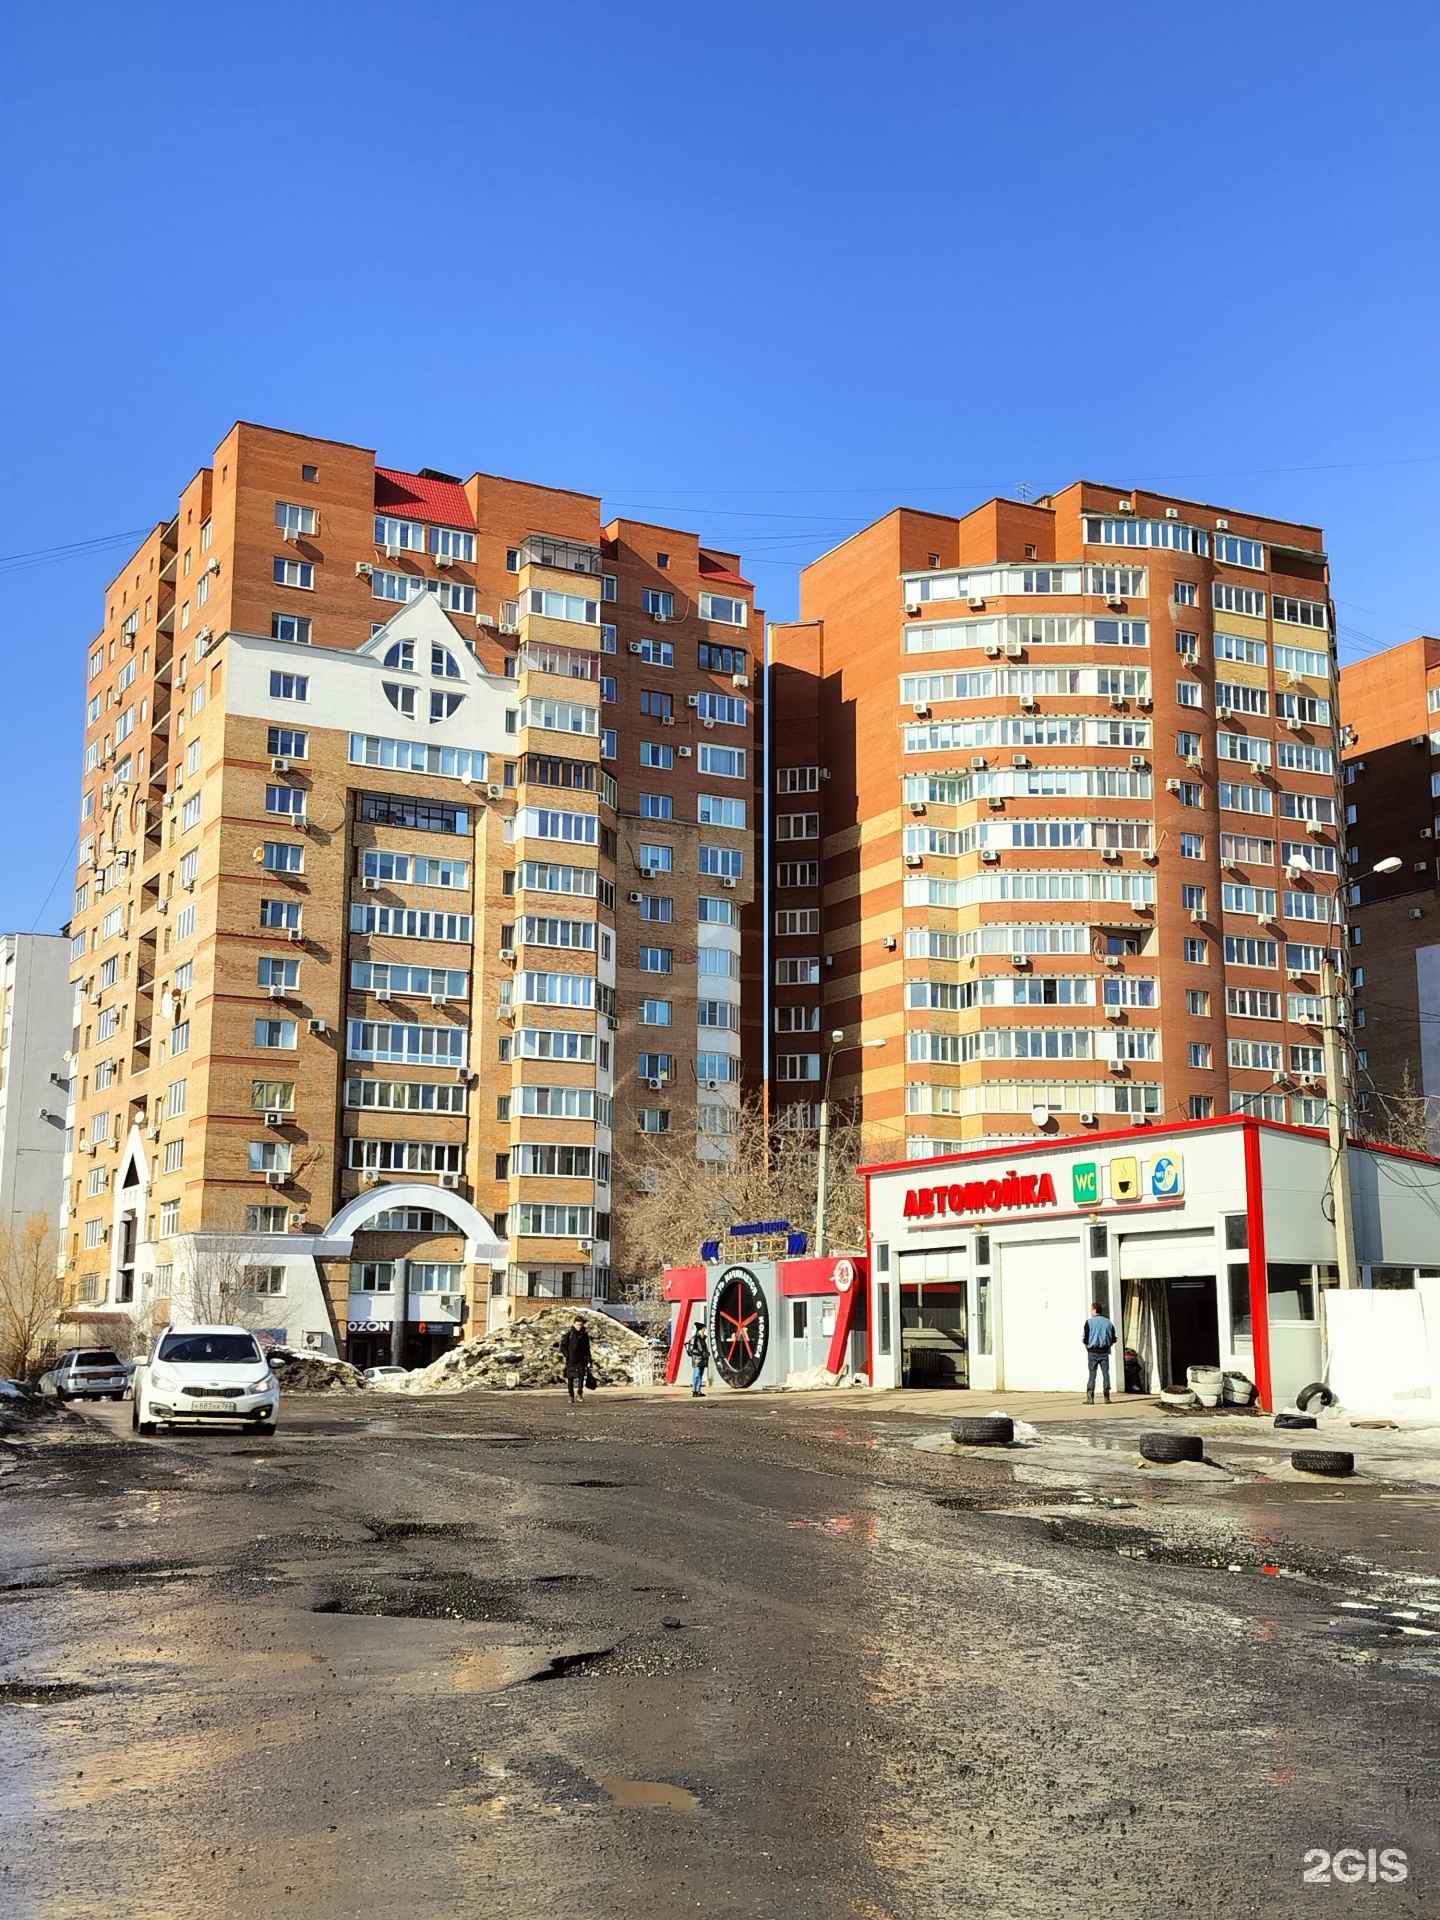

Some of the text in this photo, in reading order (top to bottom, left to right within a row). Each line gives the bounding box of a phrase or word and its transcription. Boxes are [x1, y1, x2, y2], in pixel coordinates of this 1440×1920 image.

[1075, 1172, 1095, 1192] WC
[903, 1170, 1056, 1217] АВТОМОЙКА
[347, 1321, 390, 1332] OZON
